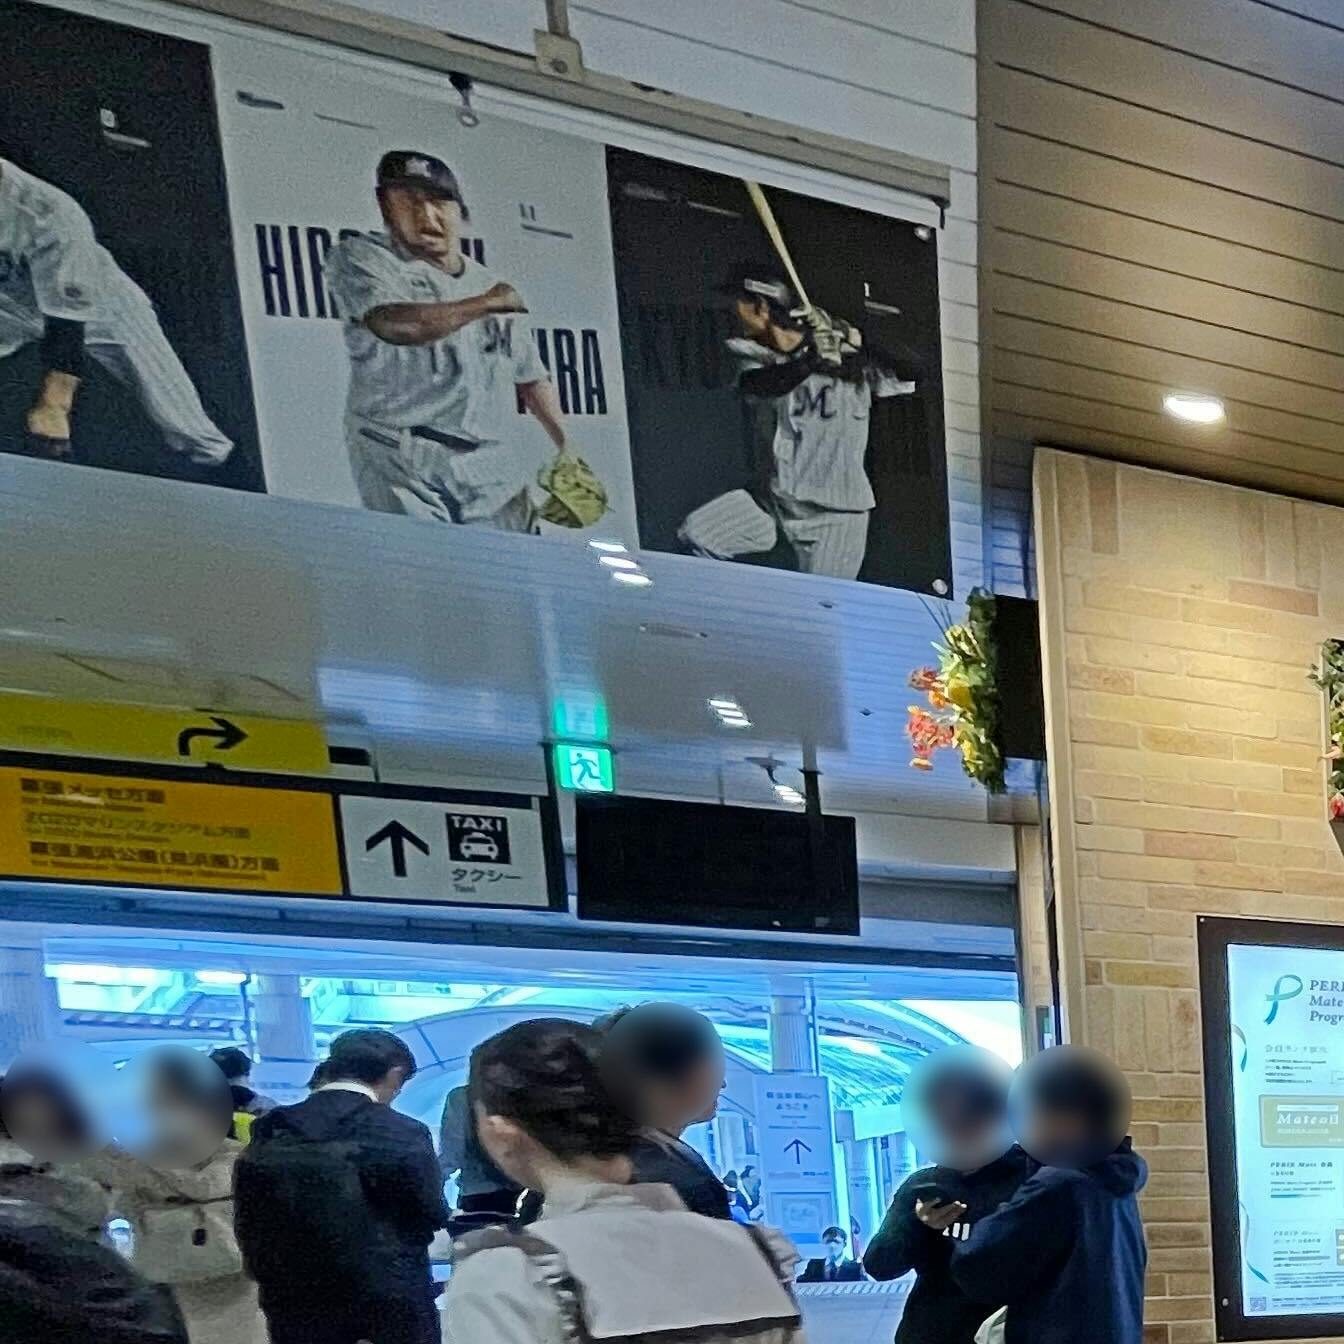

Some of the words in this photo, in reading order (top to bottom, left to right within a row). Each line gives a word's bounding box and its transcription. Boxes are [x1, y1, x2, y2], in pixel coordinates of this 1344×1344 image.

[450, 815, 502, 832] TAXI
[451, 868, 523, 882] タクシー
[1309, 995, 1344, 1008] Mate
